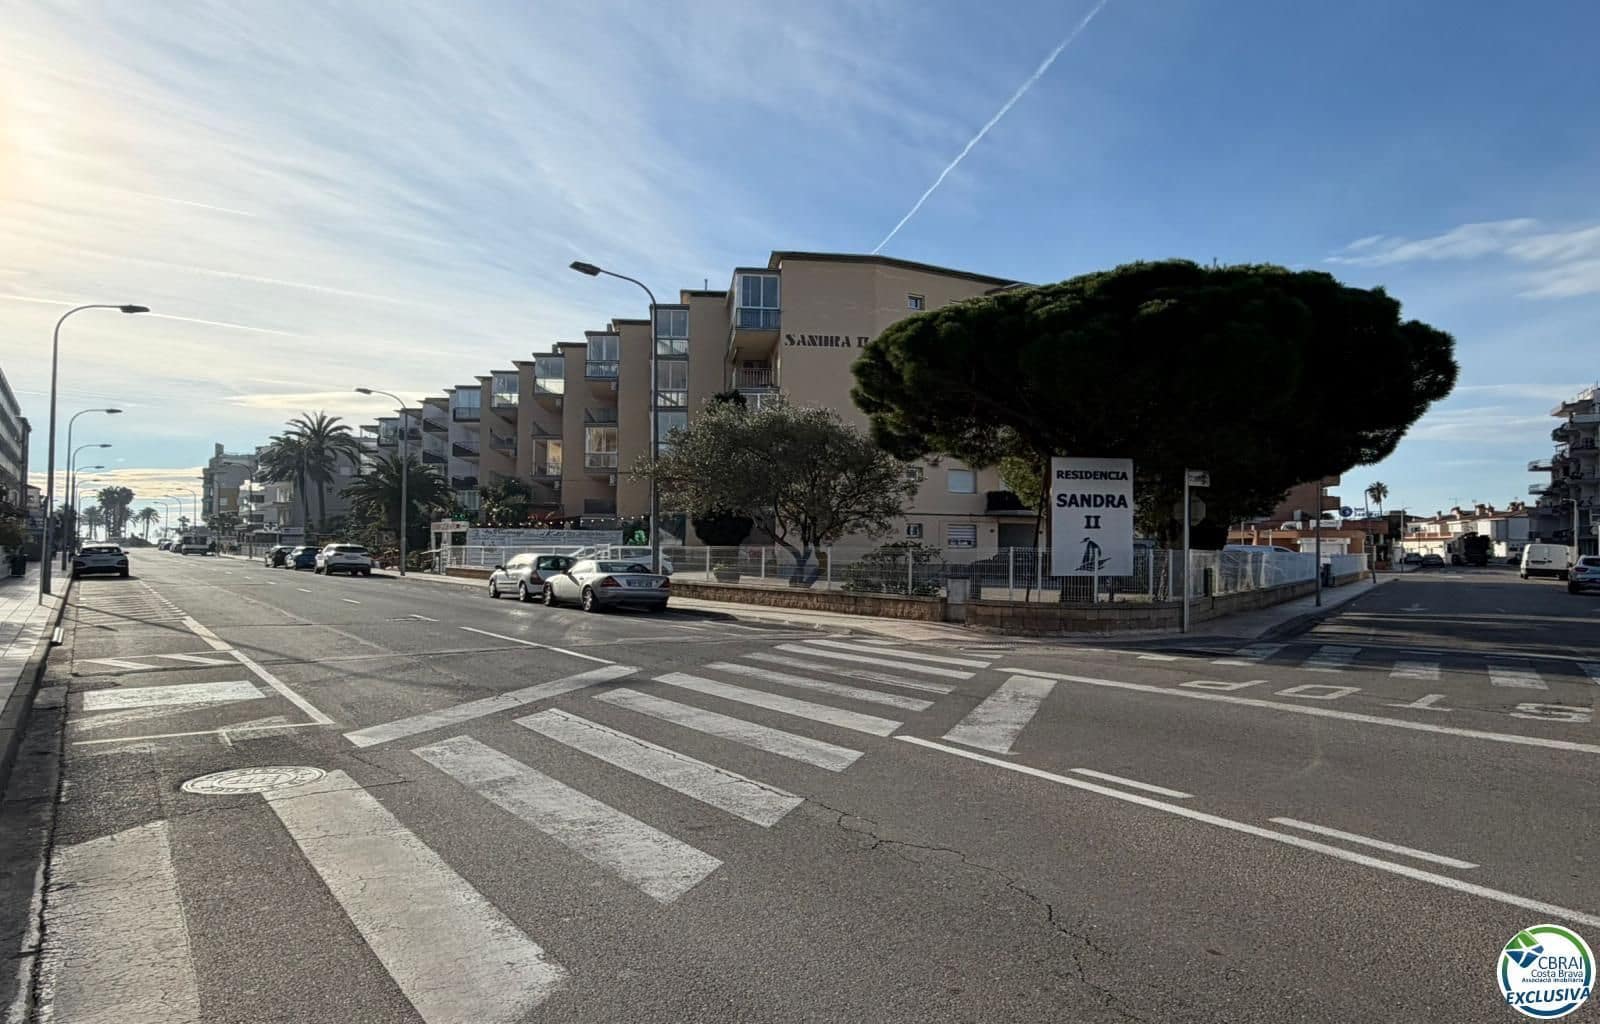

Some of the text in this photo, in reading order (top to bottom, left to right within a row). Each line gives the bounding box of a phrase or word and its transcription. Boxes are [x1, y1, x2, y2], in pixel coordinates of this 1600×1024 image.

[784, 334, 851, 347] SANDRA
[1056, 470, 1128, 480] RESIDENCIA
[1056, 493, 1128, 508] SANDRA
[1084, 515, 1101, 529] II
